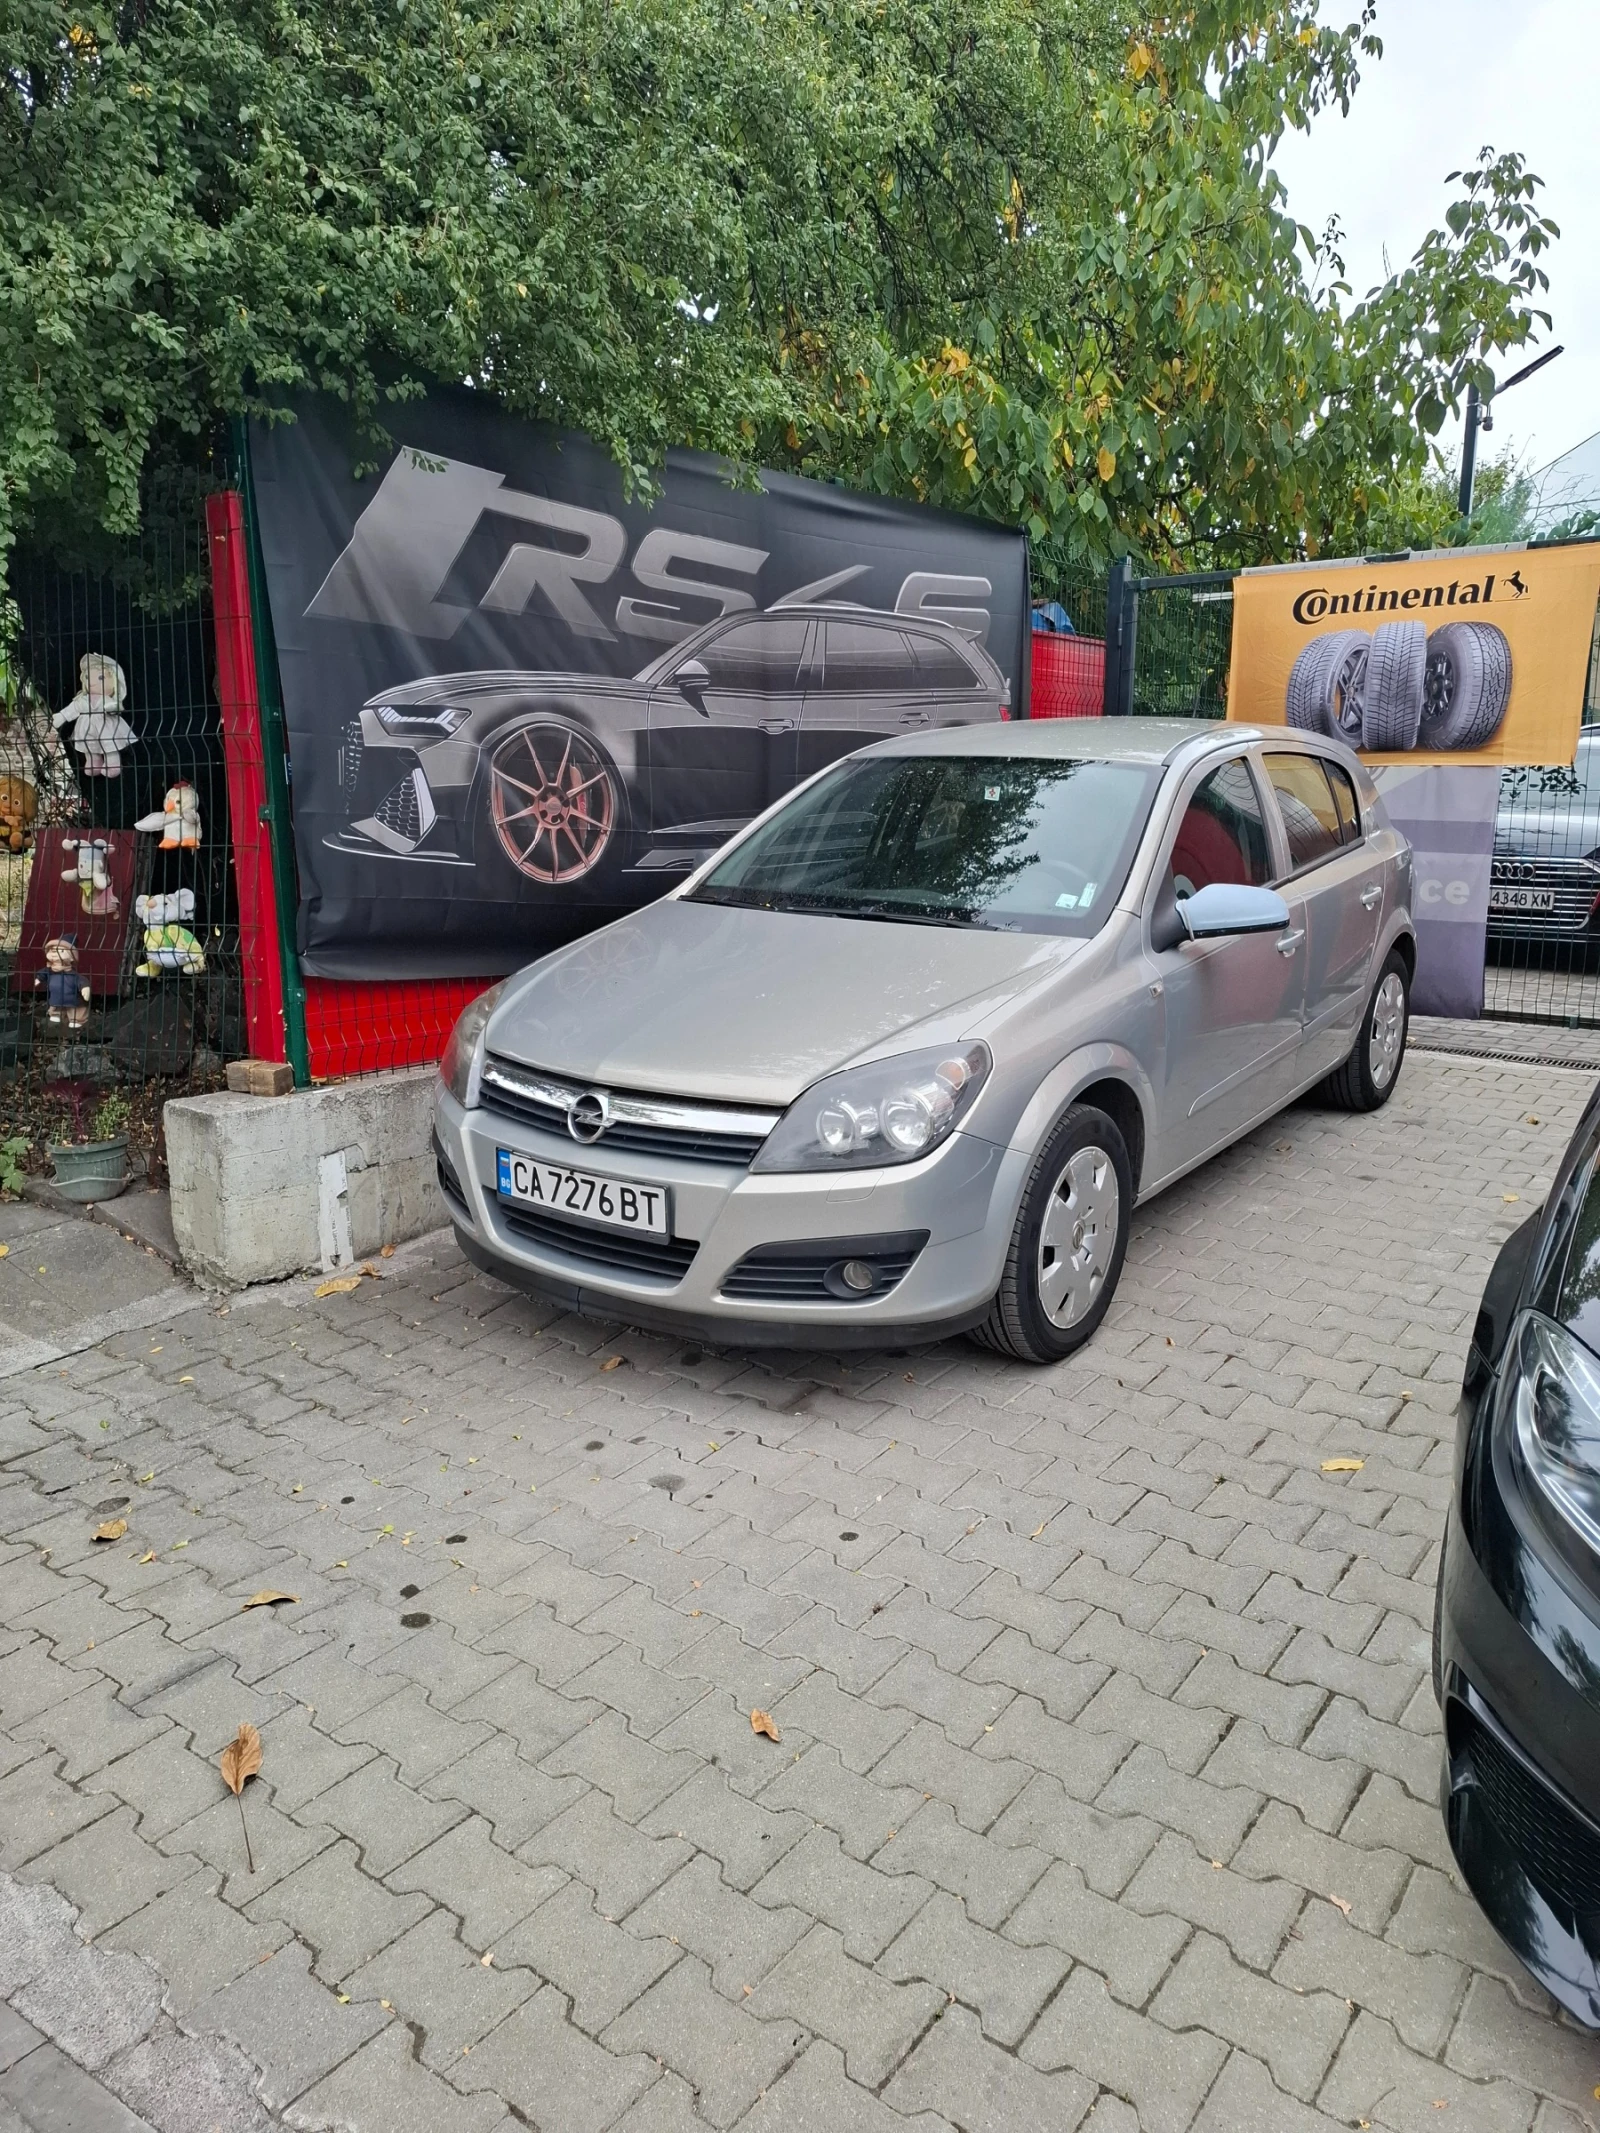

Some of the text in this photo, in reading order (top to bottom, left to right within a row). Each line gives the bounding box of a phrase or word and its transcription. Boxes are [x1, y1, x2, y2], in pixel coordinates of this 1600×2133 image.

[1292, 574, 1496, 625] Continental
[1491, 891, 1528, 906] 4348
[500, 1176, 511, 1189] BG
[548, 1170, 614, 1217] 7276
